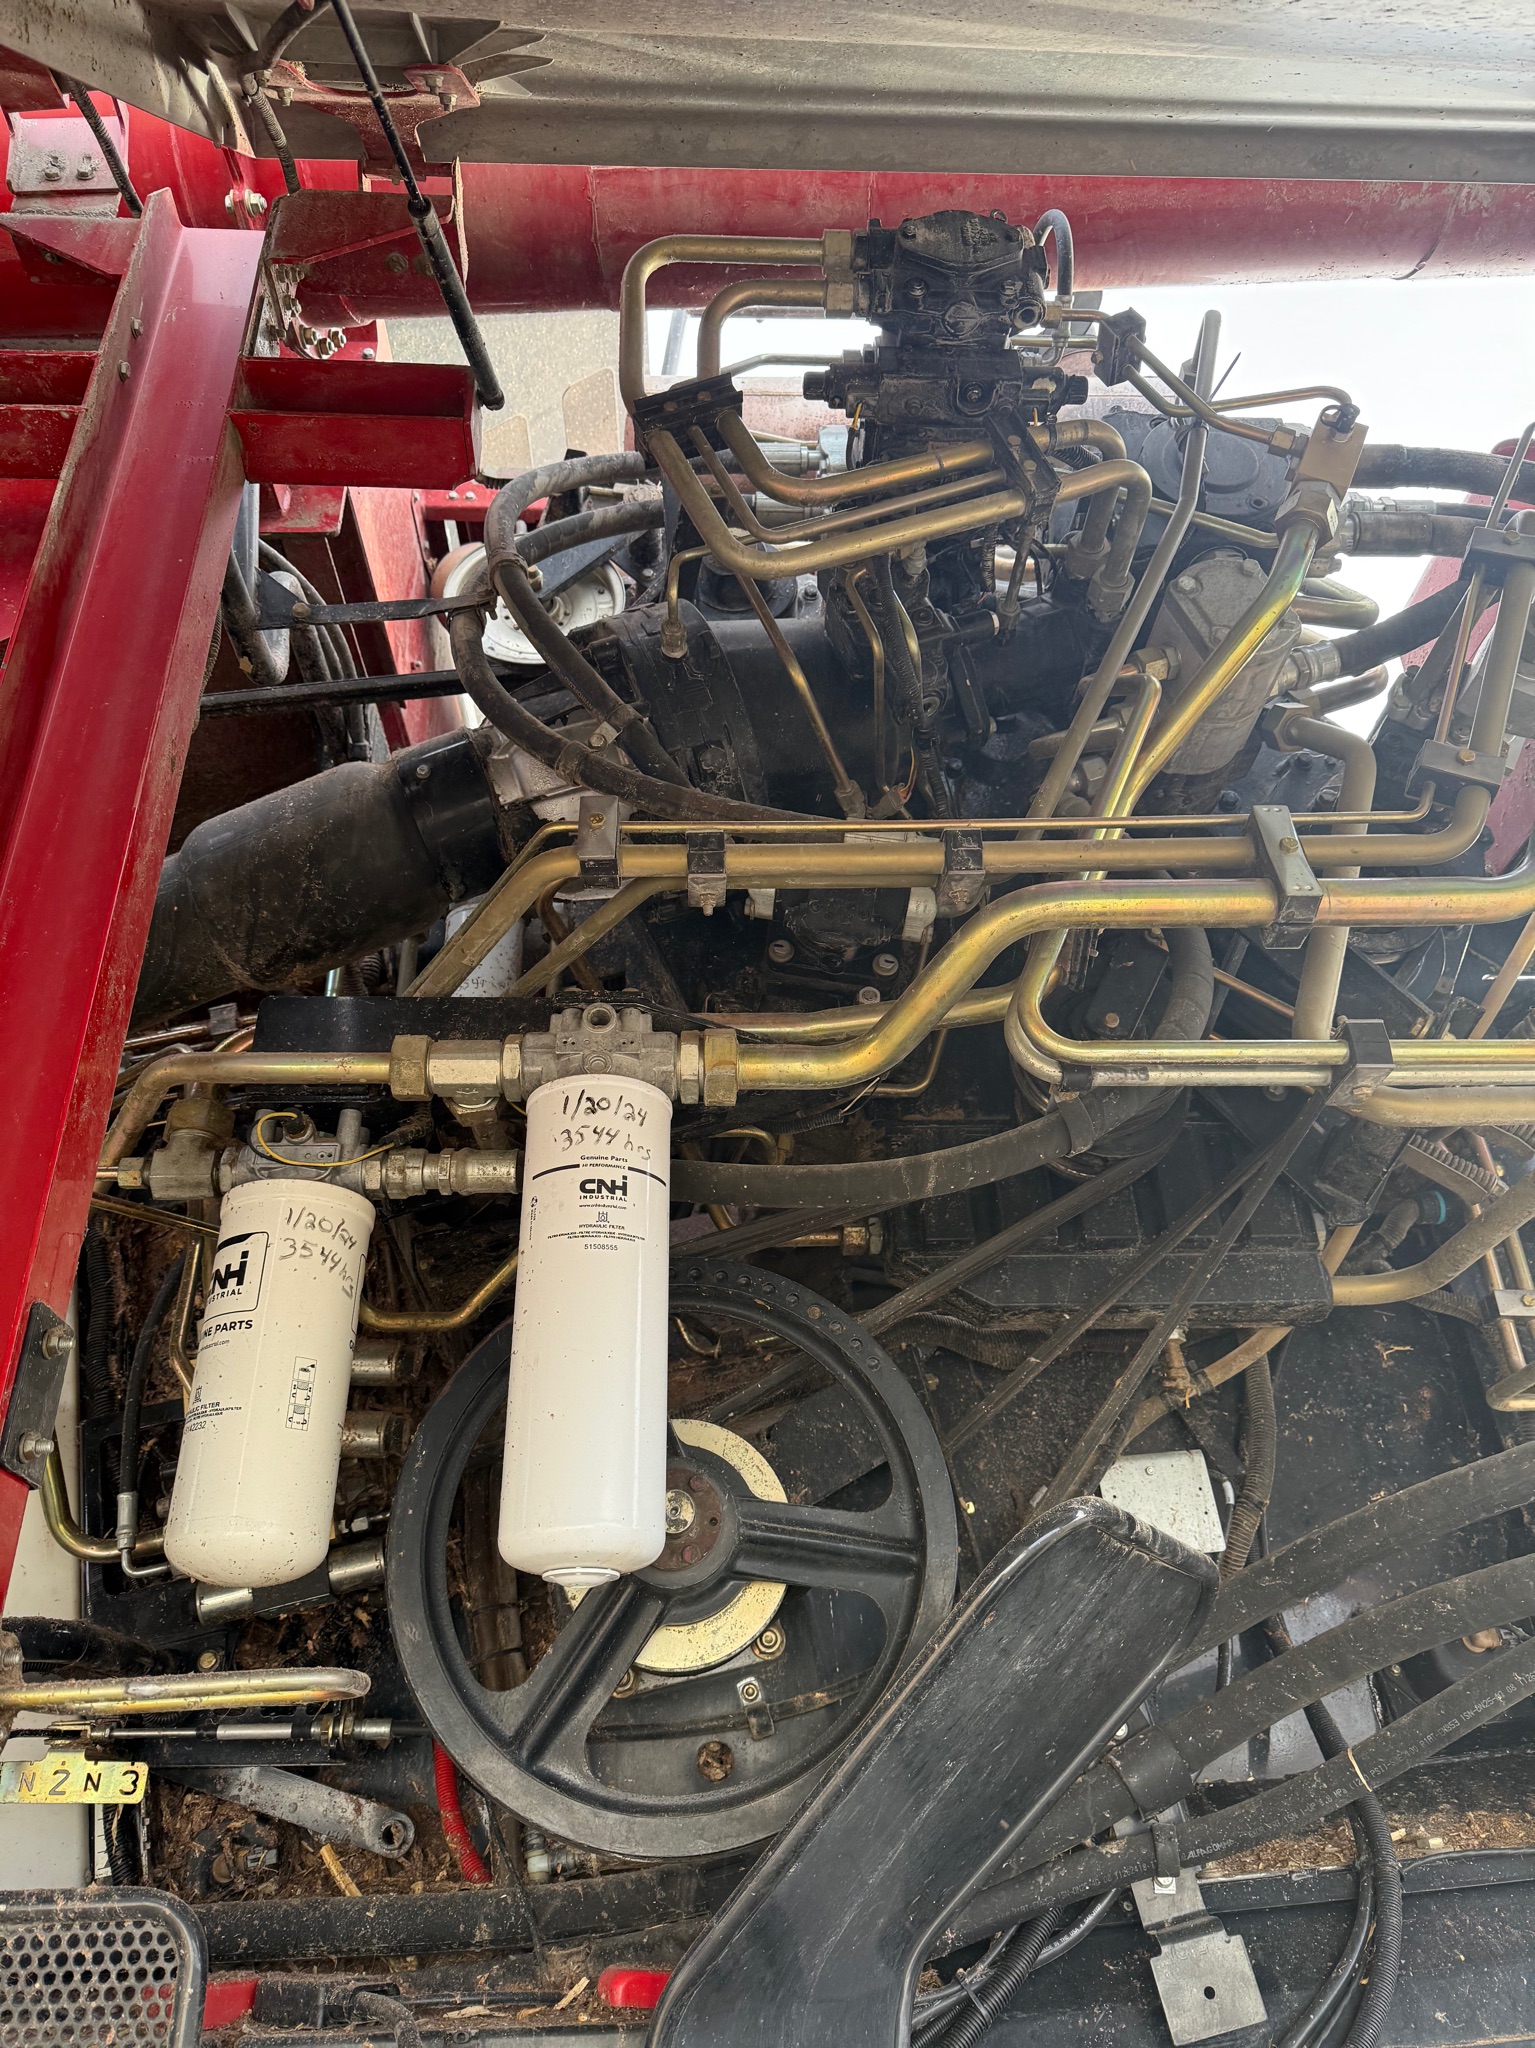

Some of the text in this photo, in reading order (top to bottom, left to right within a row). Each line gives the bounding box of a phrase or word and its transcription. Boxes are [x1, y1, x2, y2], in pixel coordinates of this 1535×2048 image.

[562, 1089, 648, 1127] 1/20/24
[560, 1125, 620, 1152] 3544
[610, 1155, 628, 1163] Parts
[579, 1194, 628, 1202] INDUSTRIAL
[286, 1206, 357, 1250] 1/20/24
[279, 1237, 342, 1273] 3544
[210, 1250, 249, 1294] NH
[214, 1319, 253, 1333] PARTS
[200, 1401, 221, 1410] FILTER
[18, 1769, 139, 1795] N 2 N 3
[1186, 1839, 1235, 1860] ALFAGOMMA
[1333, 1788, 1348, 1799] MPa
[1059, 1934, 1070, 1943] THE
[1069, 1927, 1080, 1937] USA
